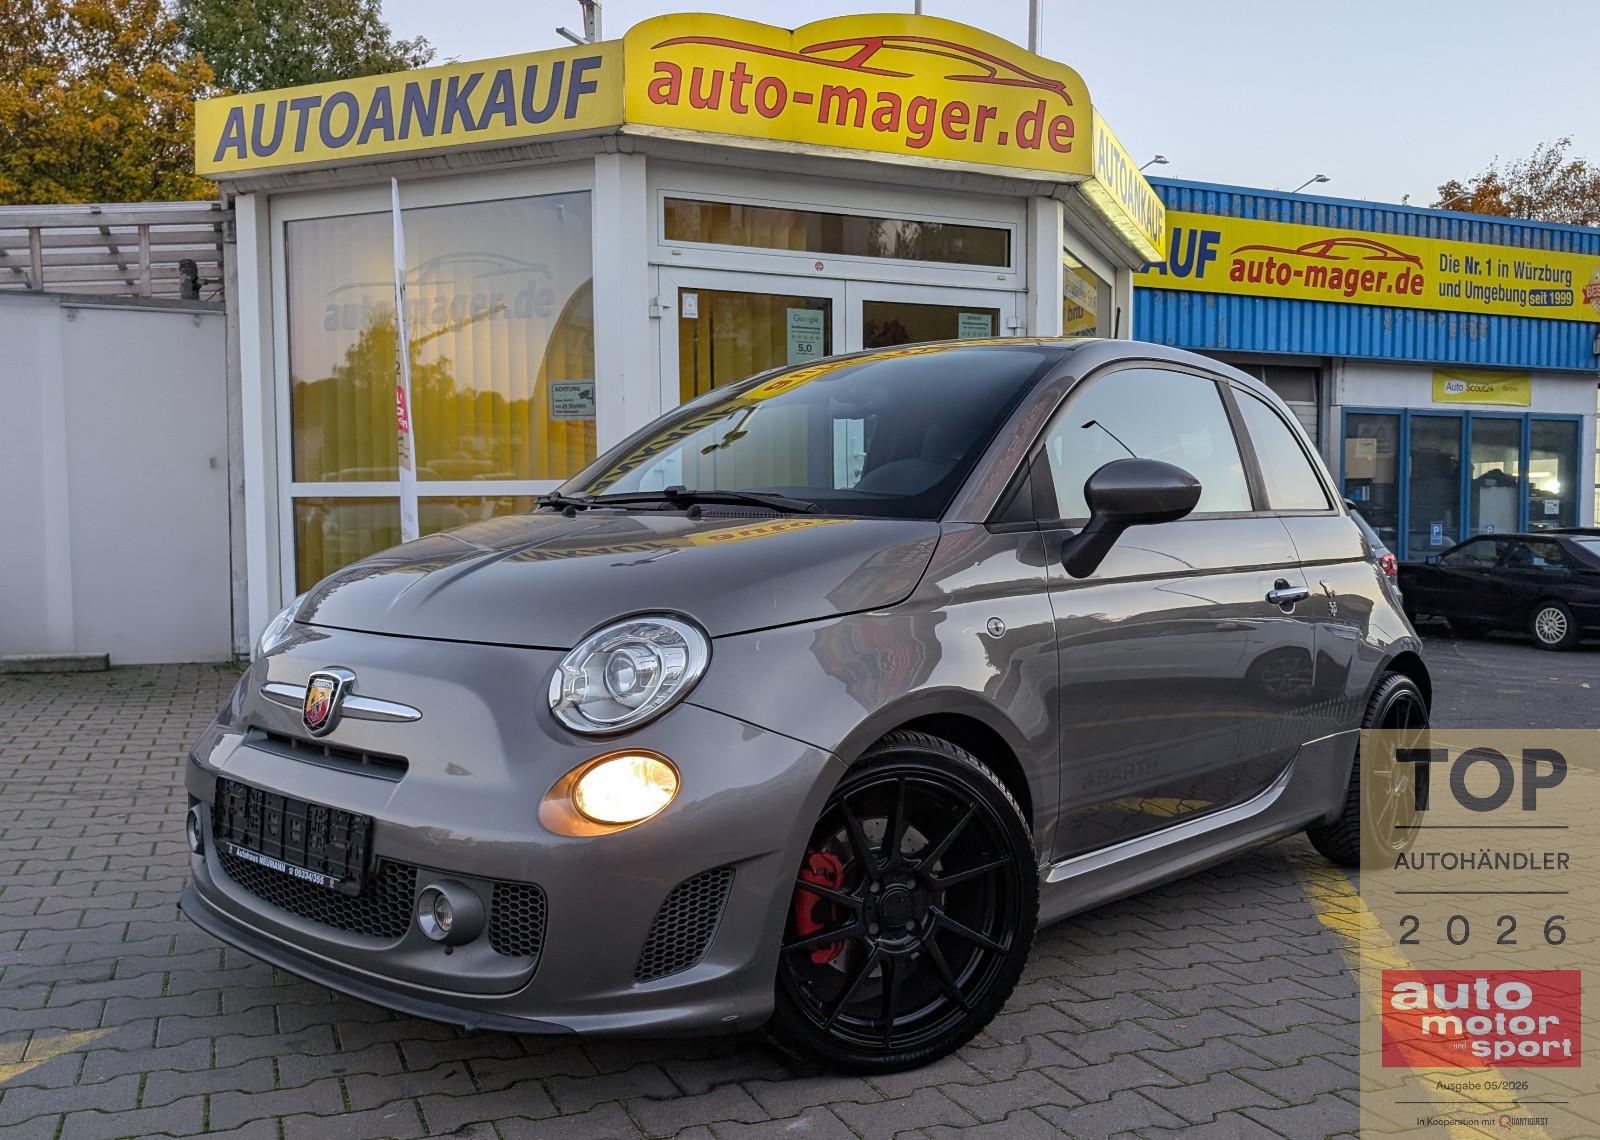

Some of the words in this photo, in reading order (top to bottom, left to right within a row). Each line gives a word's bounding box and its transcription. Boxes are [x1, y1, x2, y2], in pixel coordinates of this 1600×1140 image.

[213, 56, 603, 161] AUTOANKAUF
[647, 61, 1075, 153] auto-mager.de
[1098, 127, 1163, 246] AUTOANKAUF
[1229, 256, 1424, 298] auto-mager.de
[1439, 253, 1460, 273] Die
[1464, 257, 1482, 276] Nr.
[1486, 258, 1492, 277] 1
[1498, 259, 1509, 278] in
[1513, 259, 1572, 288] Würzburg
[1439, 280, 1461, 298] und
[1464, 281, 1527, 307] Umgebung
[1529, 290, 1548, 305] seit
[1549, 291, 1572, 305] 1999
[798, 343, 813, 353] 5,0
[1446, 381, 1463, 391] Auto
